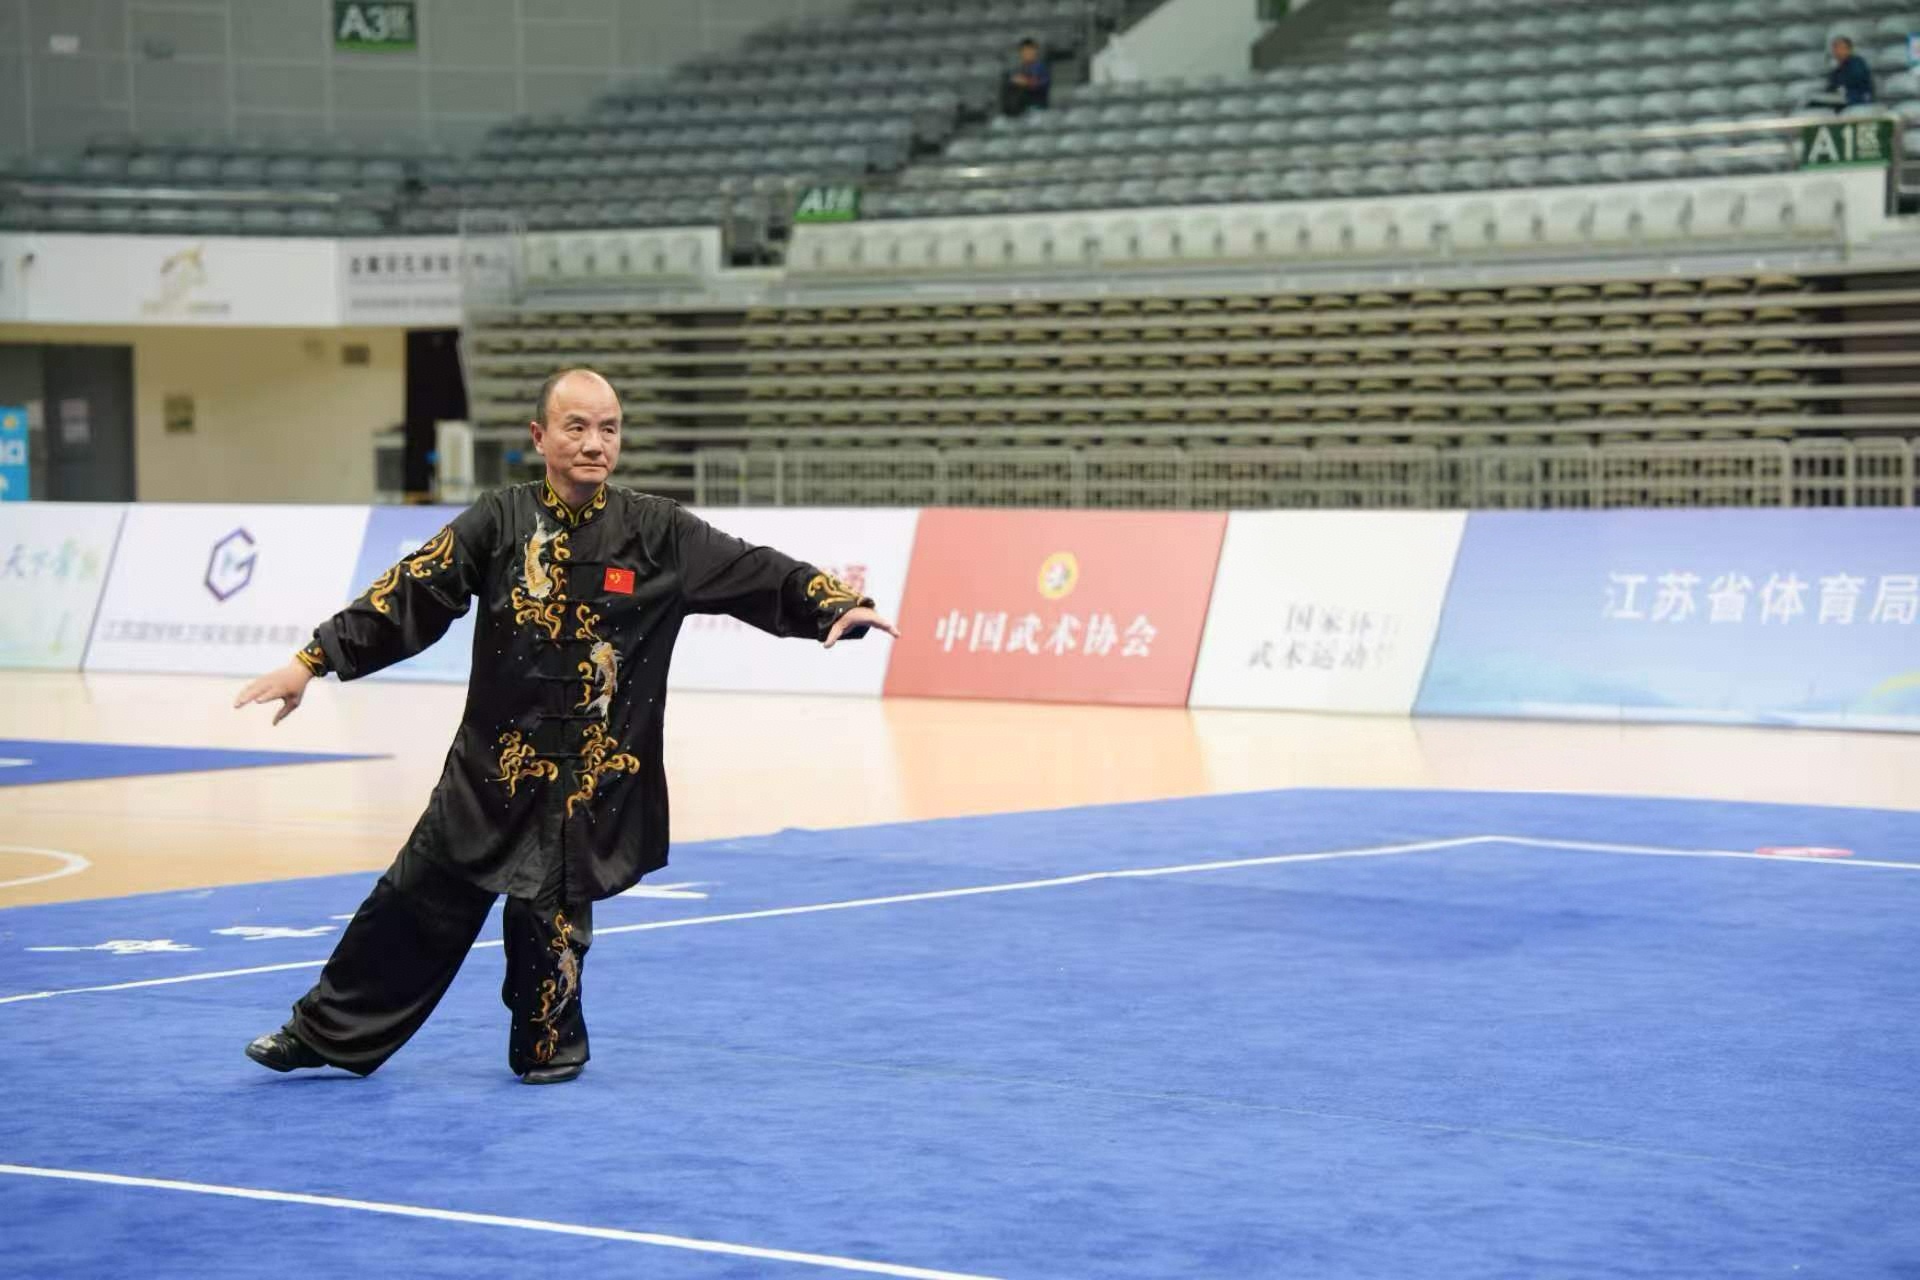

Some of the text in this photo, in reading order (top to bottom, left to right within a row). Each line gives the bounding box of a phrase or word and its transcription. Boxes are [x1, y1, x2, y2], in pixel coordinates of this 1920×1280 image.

[1602, 571, 1919, 625] 江苏省体育局
[935, 608, 1158, 657] 中国武术协会
